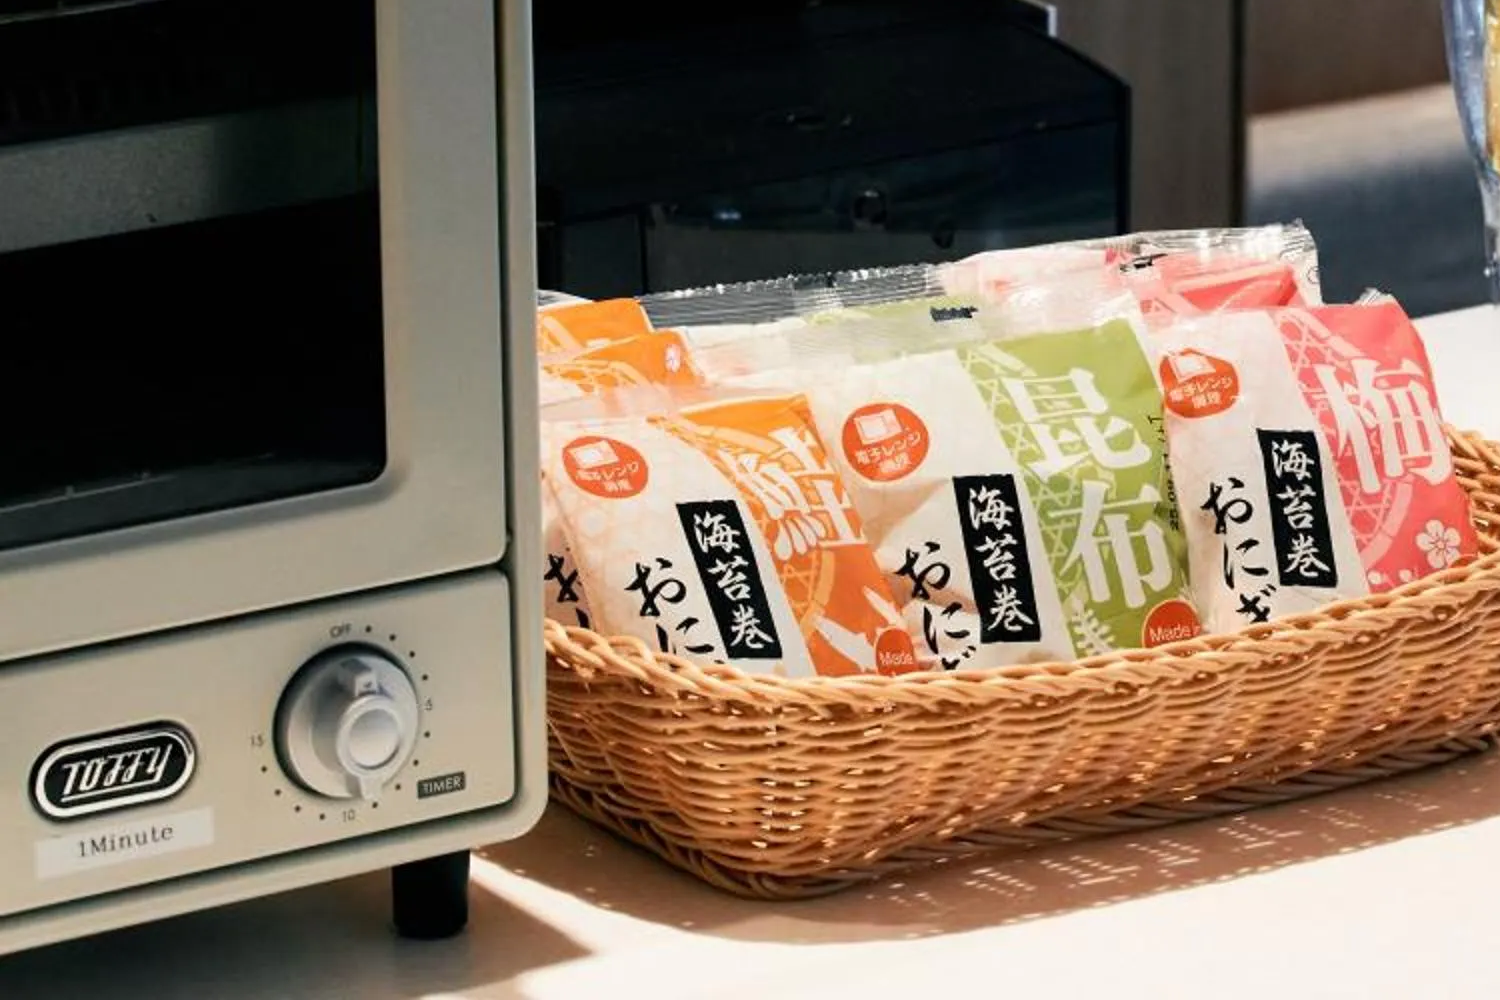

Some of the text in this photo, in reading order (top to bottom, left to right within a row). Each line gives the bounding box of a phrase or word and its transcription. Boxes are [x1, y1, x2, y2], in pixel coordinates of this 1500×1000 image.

[1313, 358, 1453, 486] 梅
[717, 425, 868, 561] 鮭
[1002, 366, 1174, 609] 昆布
[1271, 439, 1331, 577] 海苔巻
[693, 510, 775, 649] 海苔巻
[968, 485, 1034, 632] 海苔巻
[329, 622, 353, 638] OFF
[1149, 623, 1192, 643] Made
[78, 825, 174, 858] 1Minute
[342, 809, 355, 822] 10
[423, 776, 461, 795] TIMER
